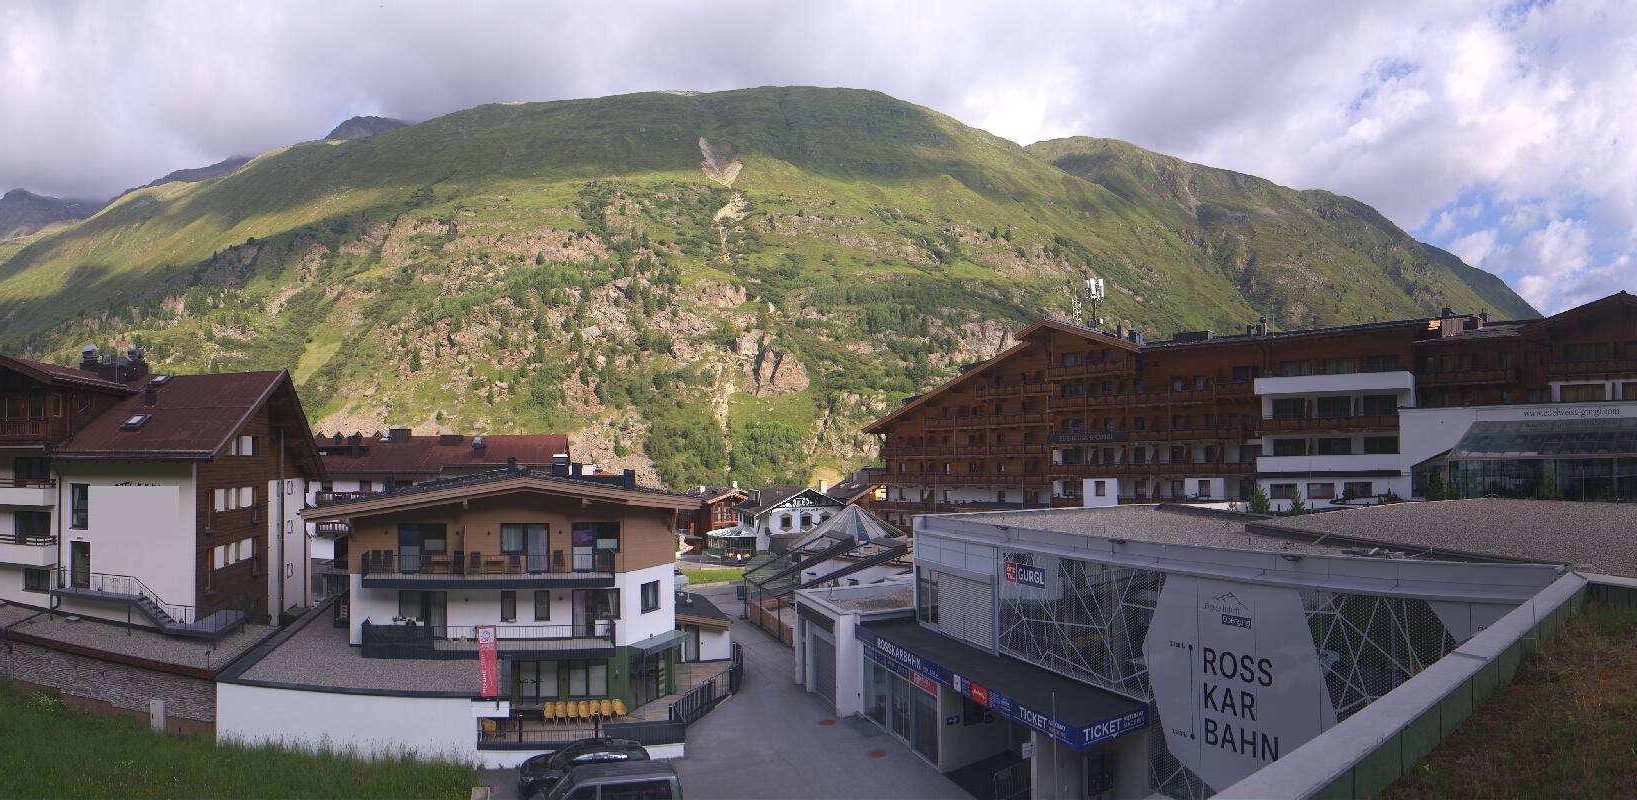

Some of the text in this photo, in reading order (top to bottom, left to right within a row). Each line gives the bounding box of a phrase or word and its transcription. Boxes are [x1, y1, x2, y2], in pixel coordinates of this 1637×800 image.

[1524, 407, 1620, 417] www.edelweiss-gurgl.com
[1018, 568, 1045, 585] GURGL
[877, 637, 921, 670] ROSSKARBAHN
[1203, 647, 1273, 687] ROSS
[1203, 682, 1257, 721] KAR
[1019, 706, 1048, 729] TICKET
[1083, 717, 1123, 742] TICKET
[1204, 717, 1279, 762] BAHN
